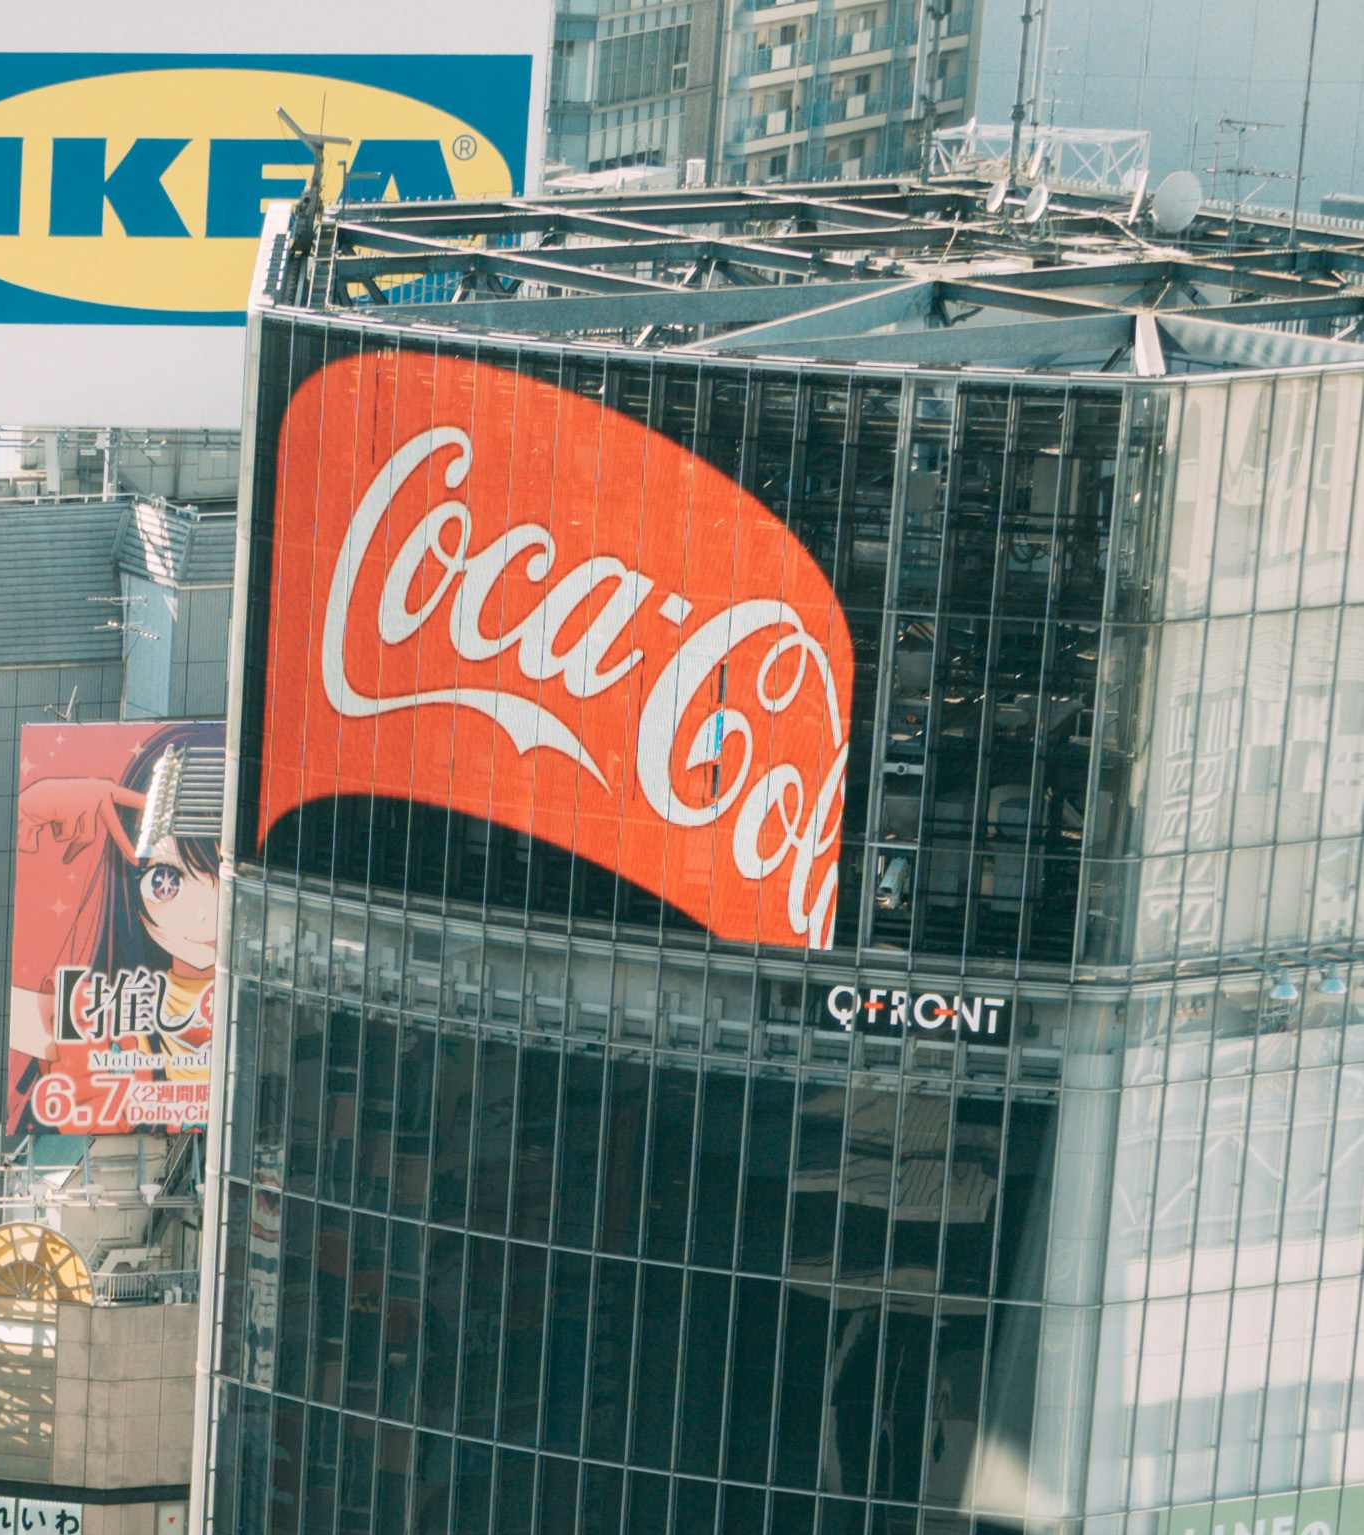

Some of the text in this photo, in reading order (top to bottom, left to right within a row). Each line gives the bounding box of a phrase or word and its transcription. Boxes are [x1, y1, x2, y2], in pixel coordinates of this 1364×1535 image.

[828, 985, 1006, 1035] QFRONT
[92, 1053, 207, 1067] Mother and
[34, 1077, 133, 1123] 6.7
